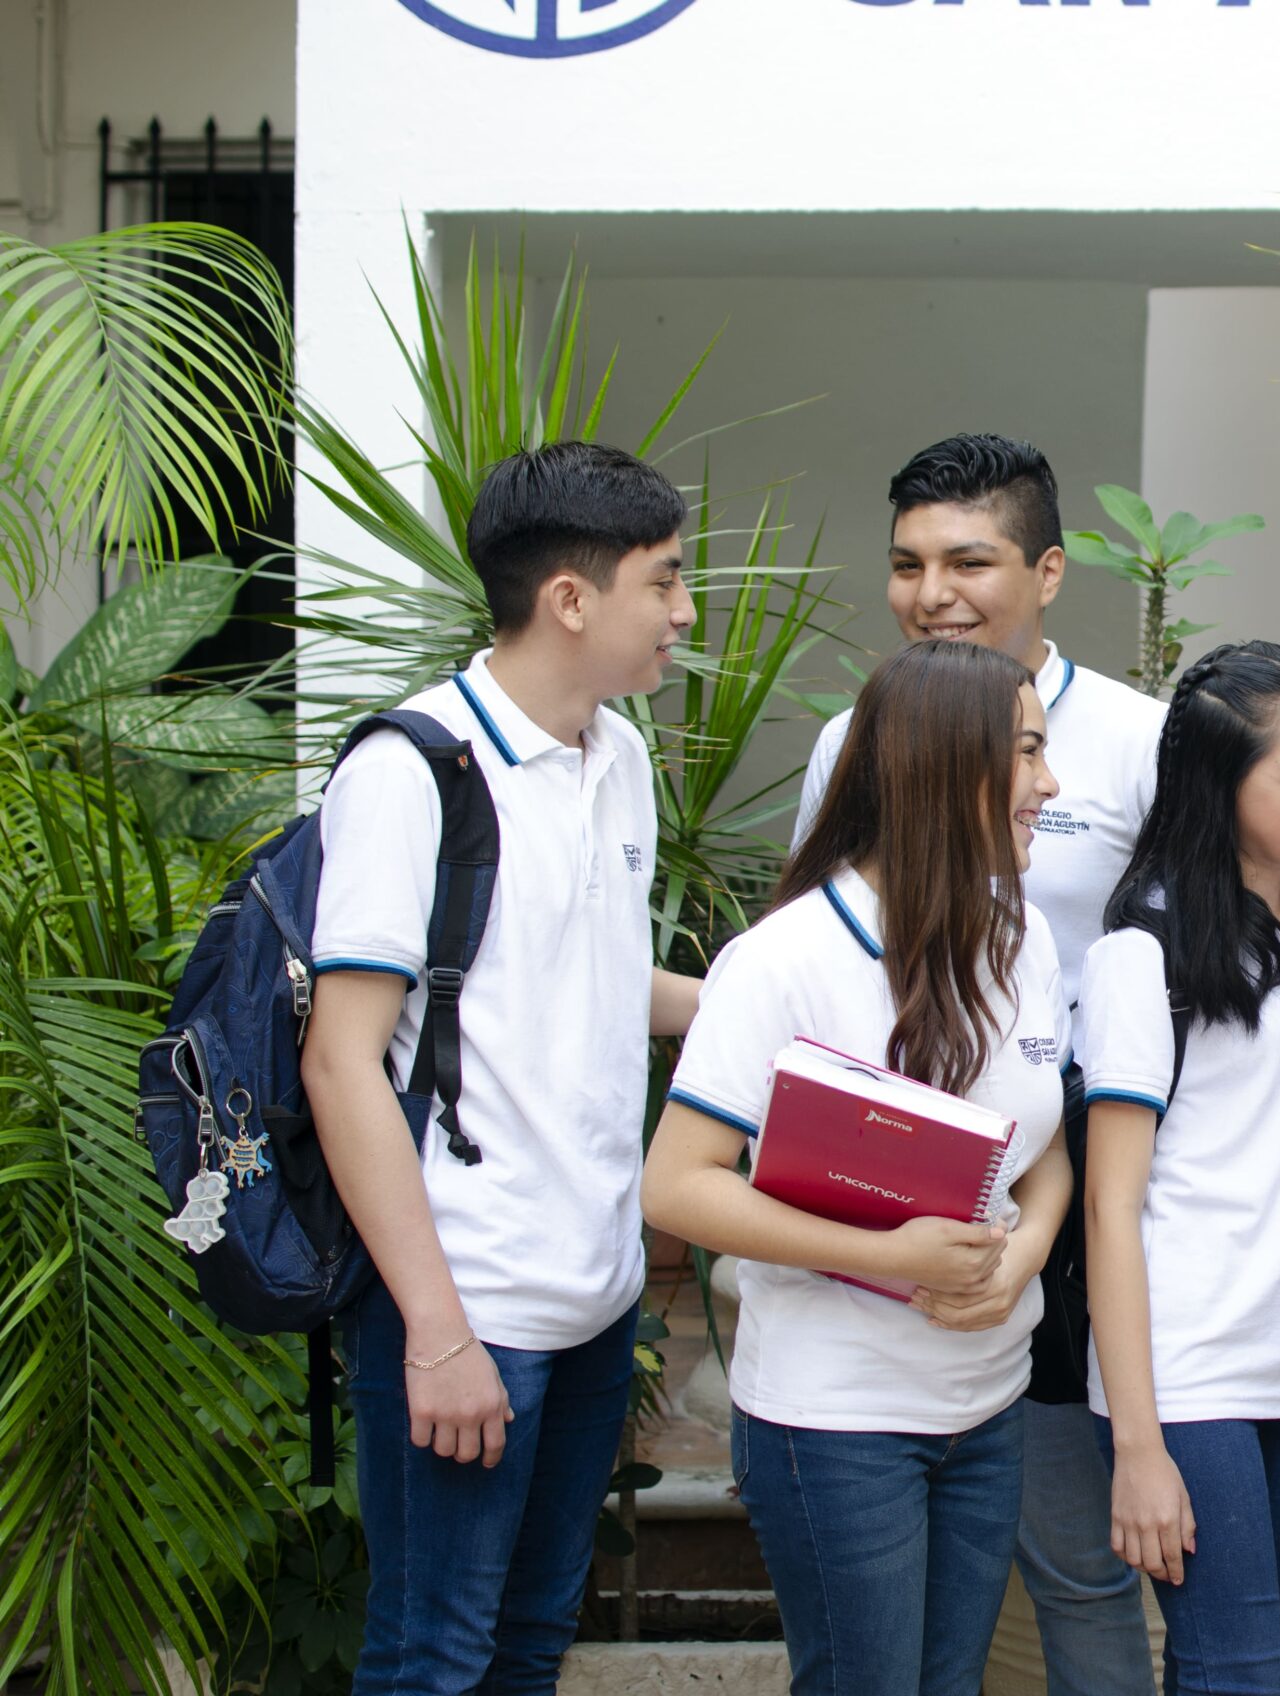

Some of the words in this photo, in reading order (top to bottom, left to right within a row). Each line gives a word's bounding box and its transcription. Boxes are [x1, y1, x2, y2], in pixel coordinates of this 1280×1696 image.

[1040, 809, 1072, 819] OLEGIO
[1039, 818, 1052, 826] AN
[1054, 820, 1090, 831] AGUSTÍN
[865, 1109, 912, 1132] Norma
[828, 1171, 915, 1203] unicampus
